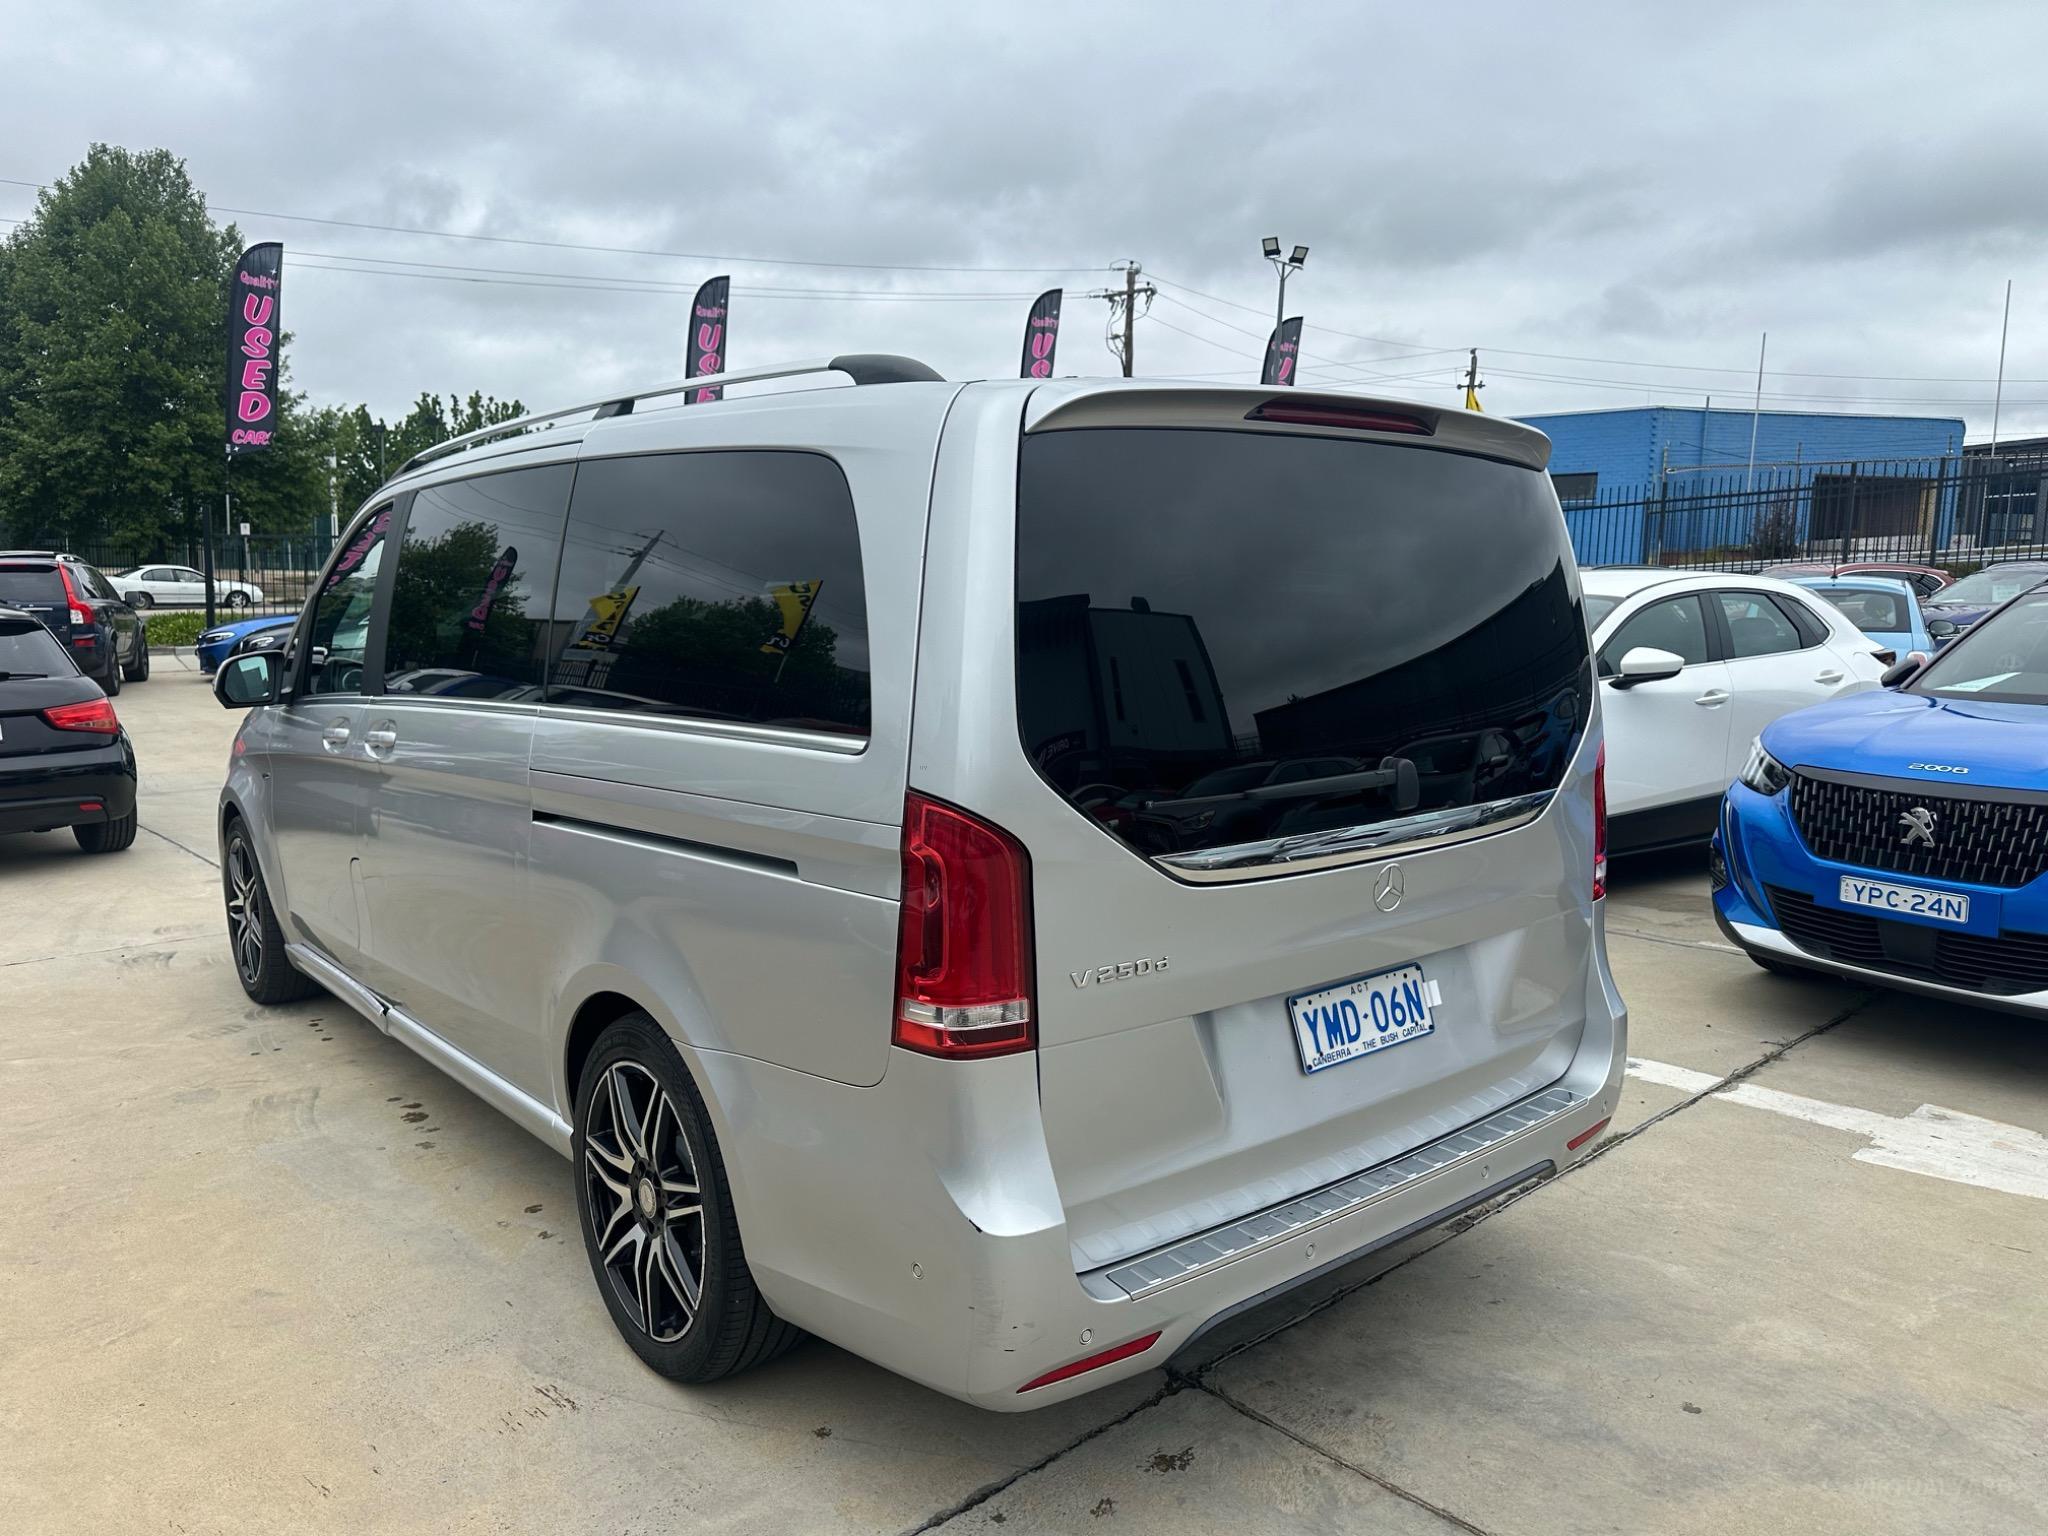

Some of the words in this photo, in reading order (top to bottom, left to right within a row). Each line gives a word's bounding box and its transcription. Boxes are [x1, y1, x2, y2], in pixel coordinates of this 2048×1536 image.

[238, 292, 273, 422] USED
[1908, 762, 1970, 774] 2008
[1350, 981, 1369, 995] ACT
[1312, 1048, 1352, 1067] CANBERRA
[1362, 1037, 1377, 1050] THE
[1380, 1032, 1399, 1045] BUSH
[1402, 1023, 1428, 1038] CAPITAL
